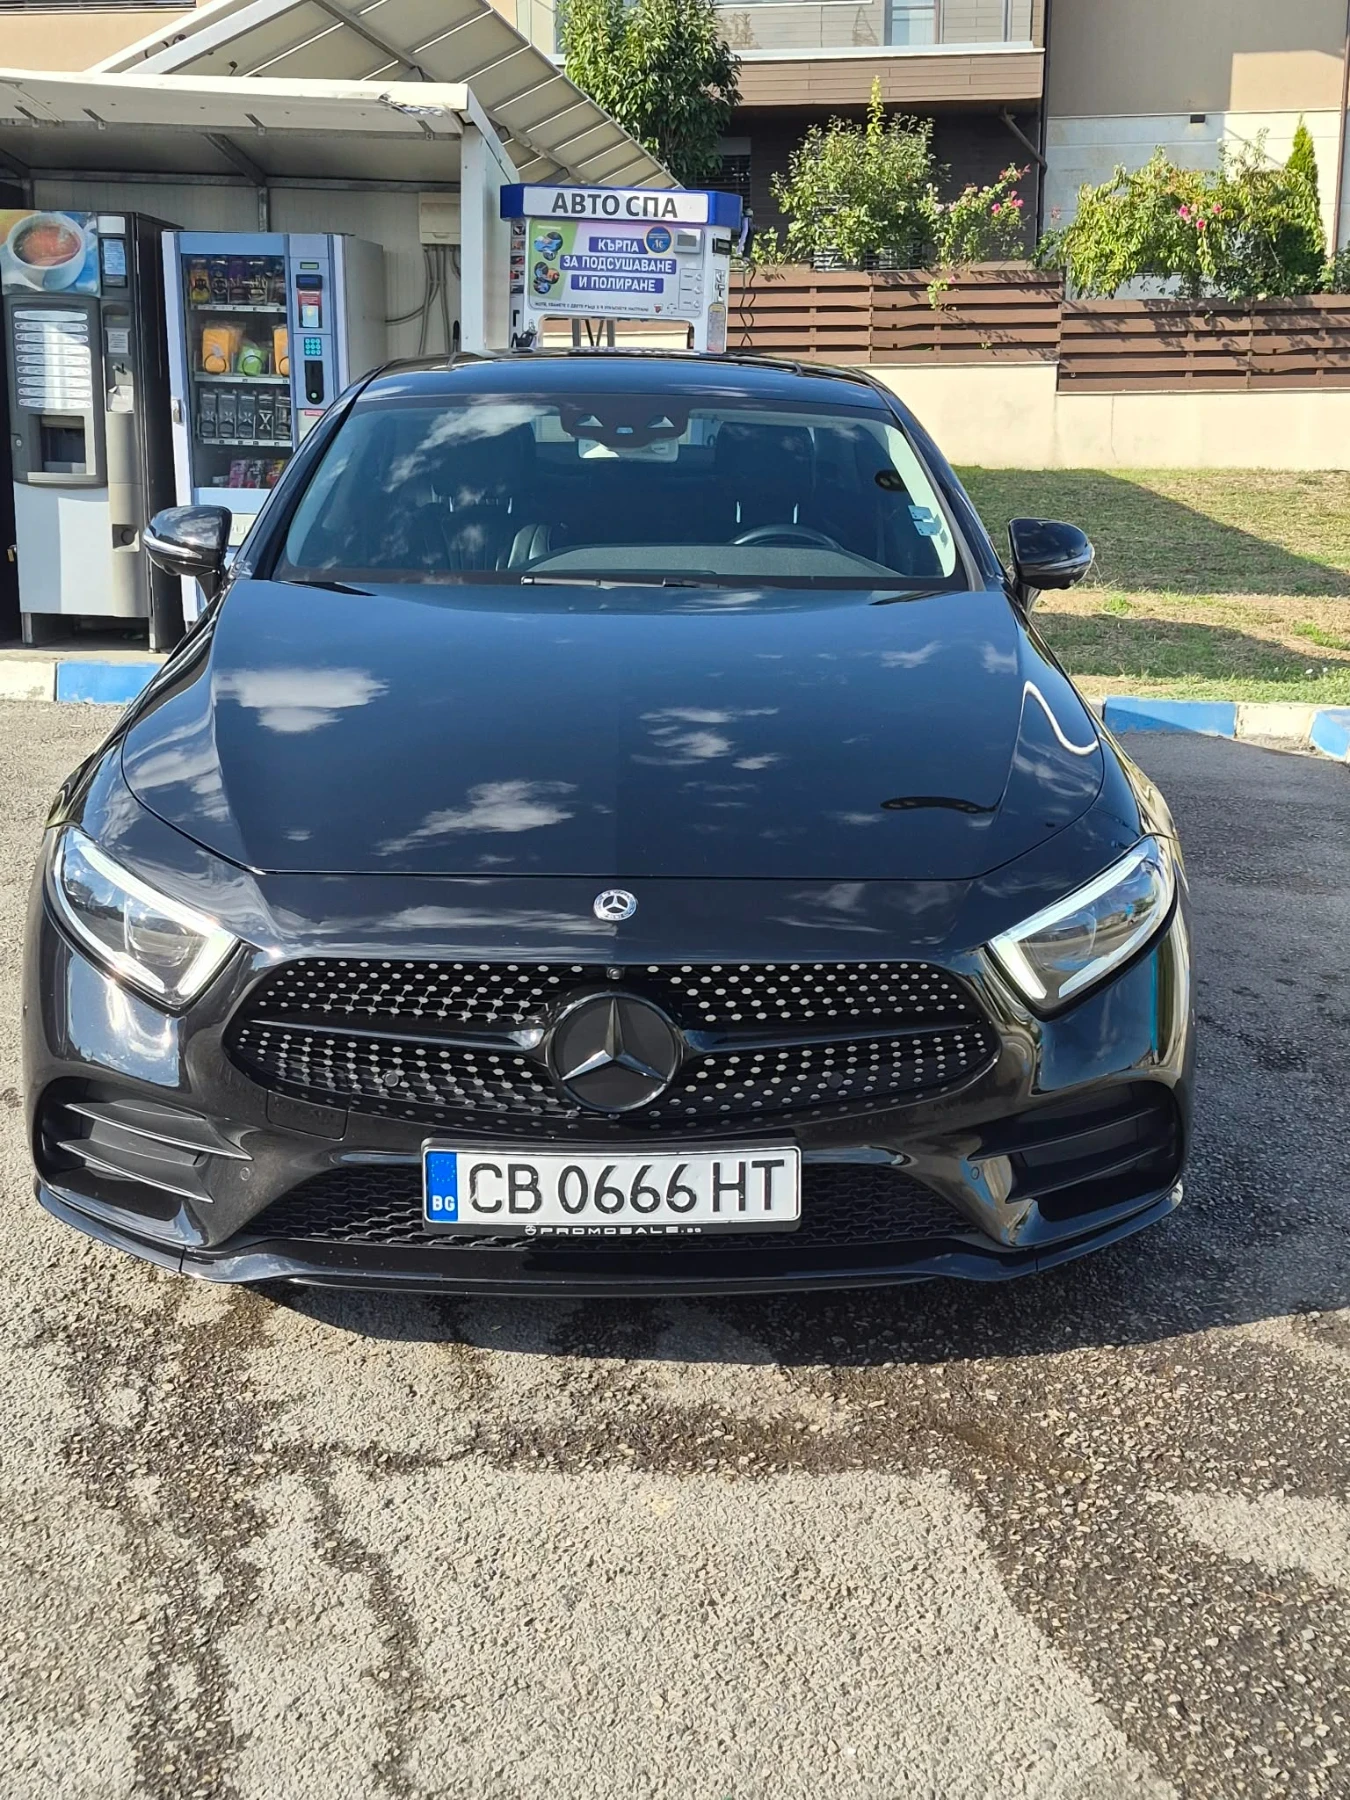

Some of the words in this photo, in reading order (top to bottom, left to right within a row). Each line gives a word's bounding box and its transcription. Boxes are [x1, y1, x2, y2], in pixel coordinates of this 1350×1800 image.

[551, 192, 620, 216] АВТО
[625, 196, 678, 218] СПА
[598, 239, 640, 253] КЪРПА
[563, 255, 578, 268] ЗА
[581, 256, 673, 272] ПОДСУШАВАНЕ
[578, 276, 587, 288] И
[591, 277, 656, 292] ПОЛИРАНЕ
[469, 1163, 542, 1214] CB
[557, 1164, 697, 1214] 0666
[712, 1159, 785, 1212] HT
[432, 1195, 455, 1212] BG
